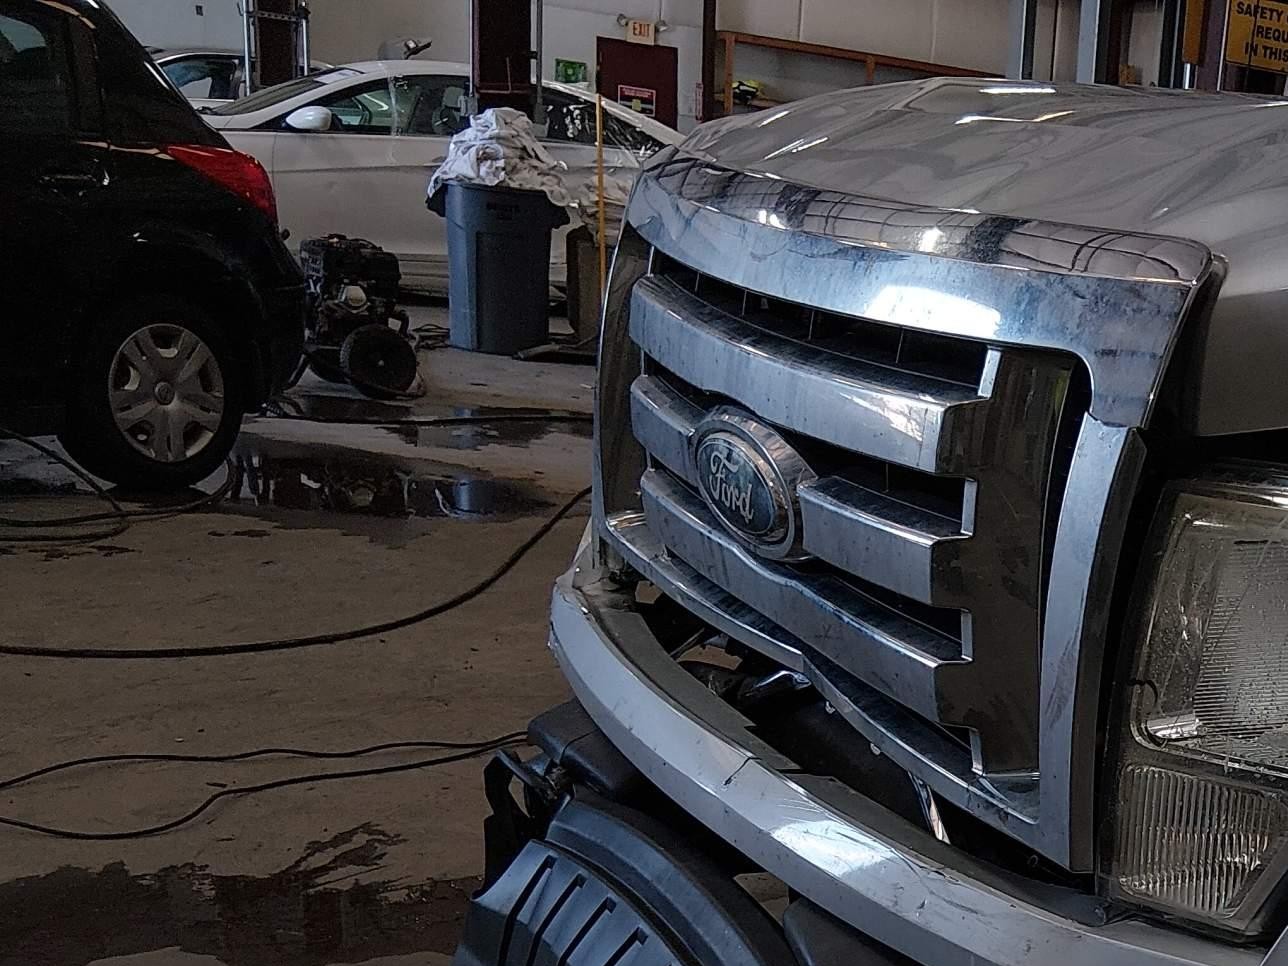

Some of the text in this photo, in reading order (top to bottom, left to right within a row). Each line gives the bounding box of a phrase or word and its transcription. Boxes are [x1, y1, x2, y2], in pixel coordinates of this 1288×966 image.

[1237, 2, 1285, 23] SAFETY
[633, 22, 650, 38] EXIT
[1244, 42, 1258, 57] IN
[711, 452, 754, 525] Ford
